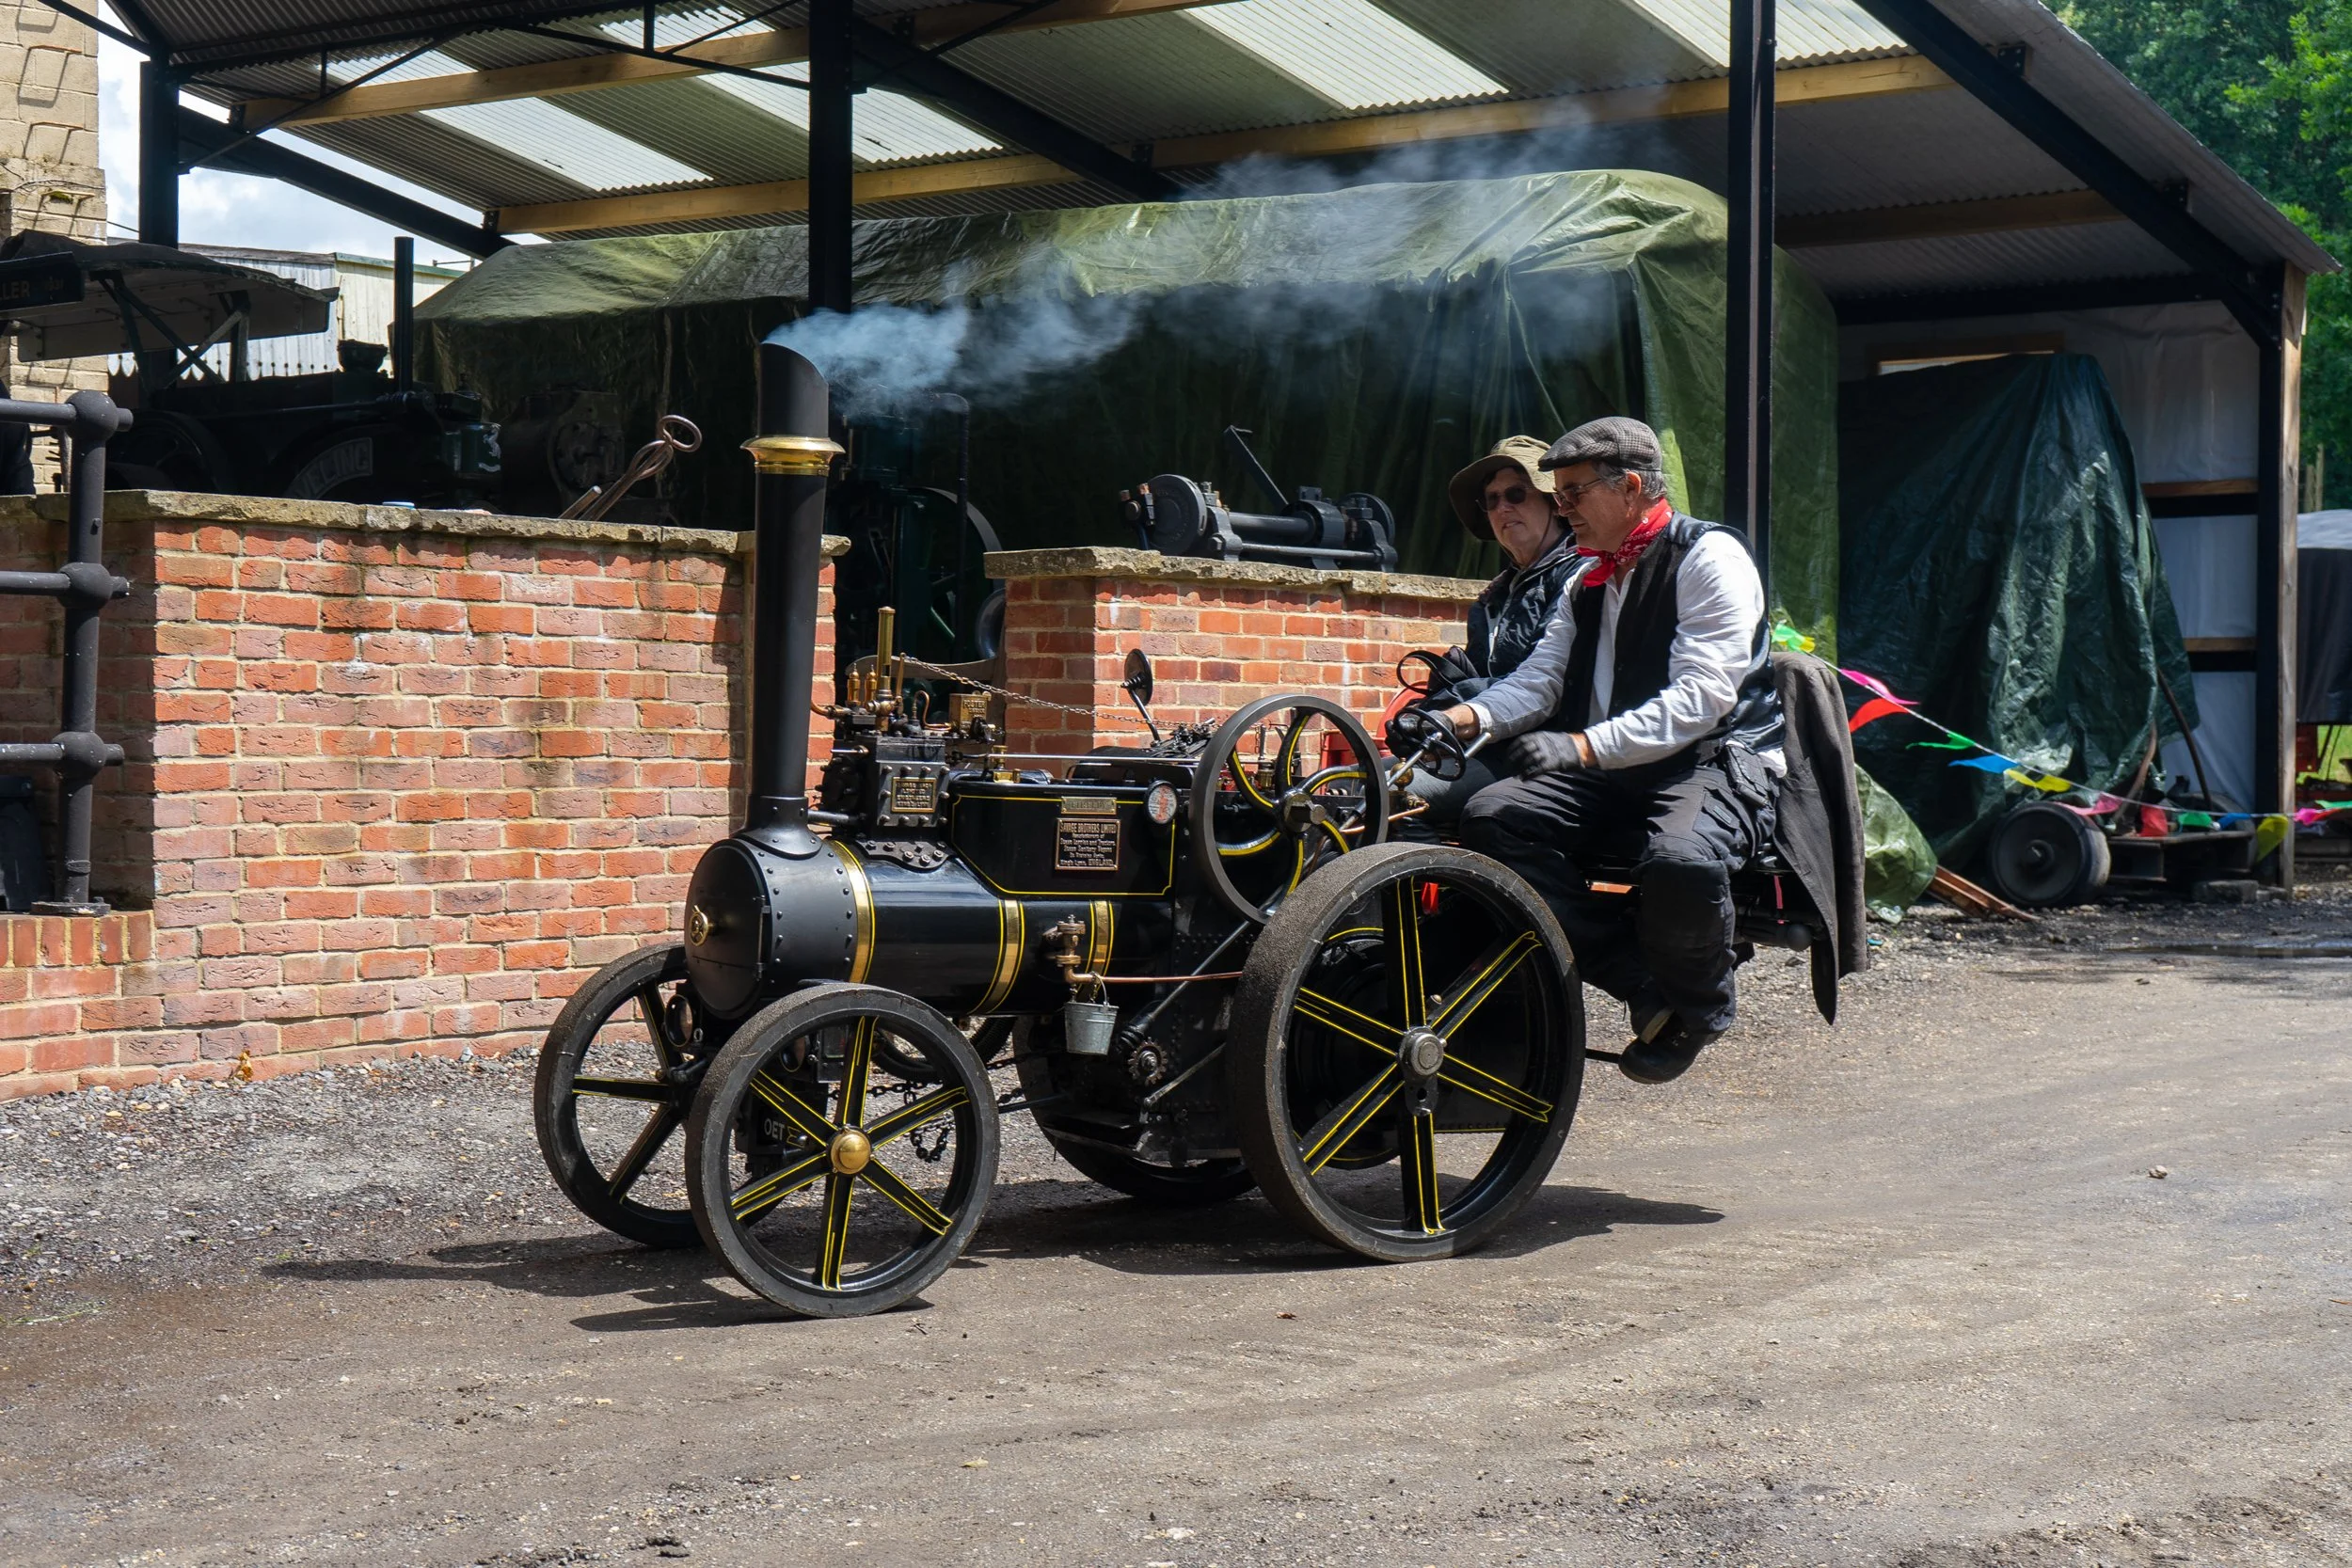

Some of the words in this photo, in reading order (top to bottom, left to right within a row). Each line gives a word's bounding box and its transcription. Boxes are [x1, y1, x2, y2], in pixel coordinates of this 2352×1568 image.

[1059, 822, 1077, 833] SAVAGE
[1077, 822, 1100, 833] BROTHERS
[1101, 823, 1117, 833] LIMITED
